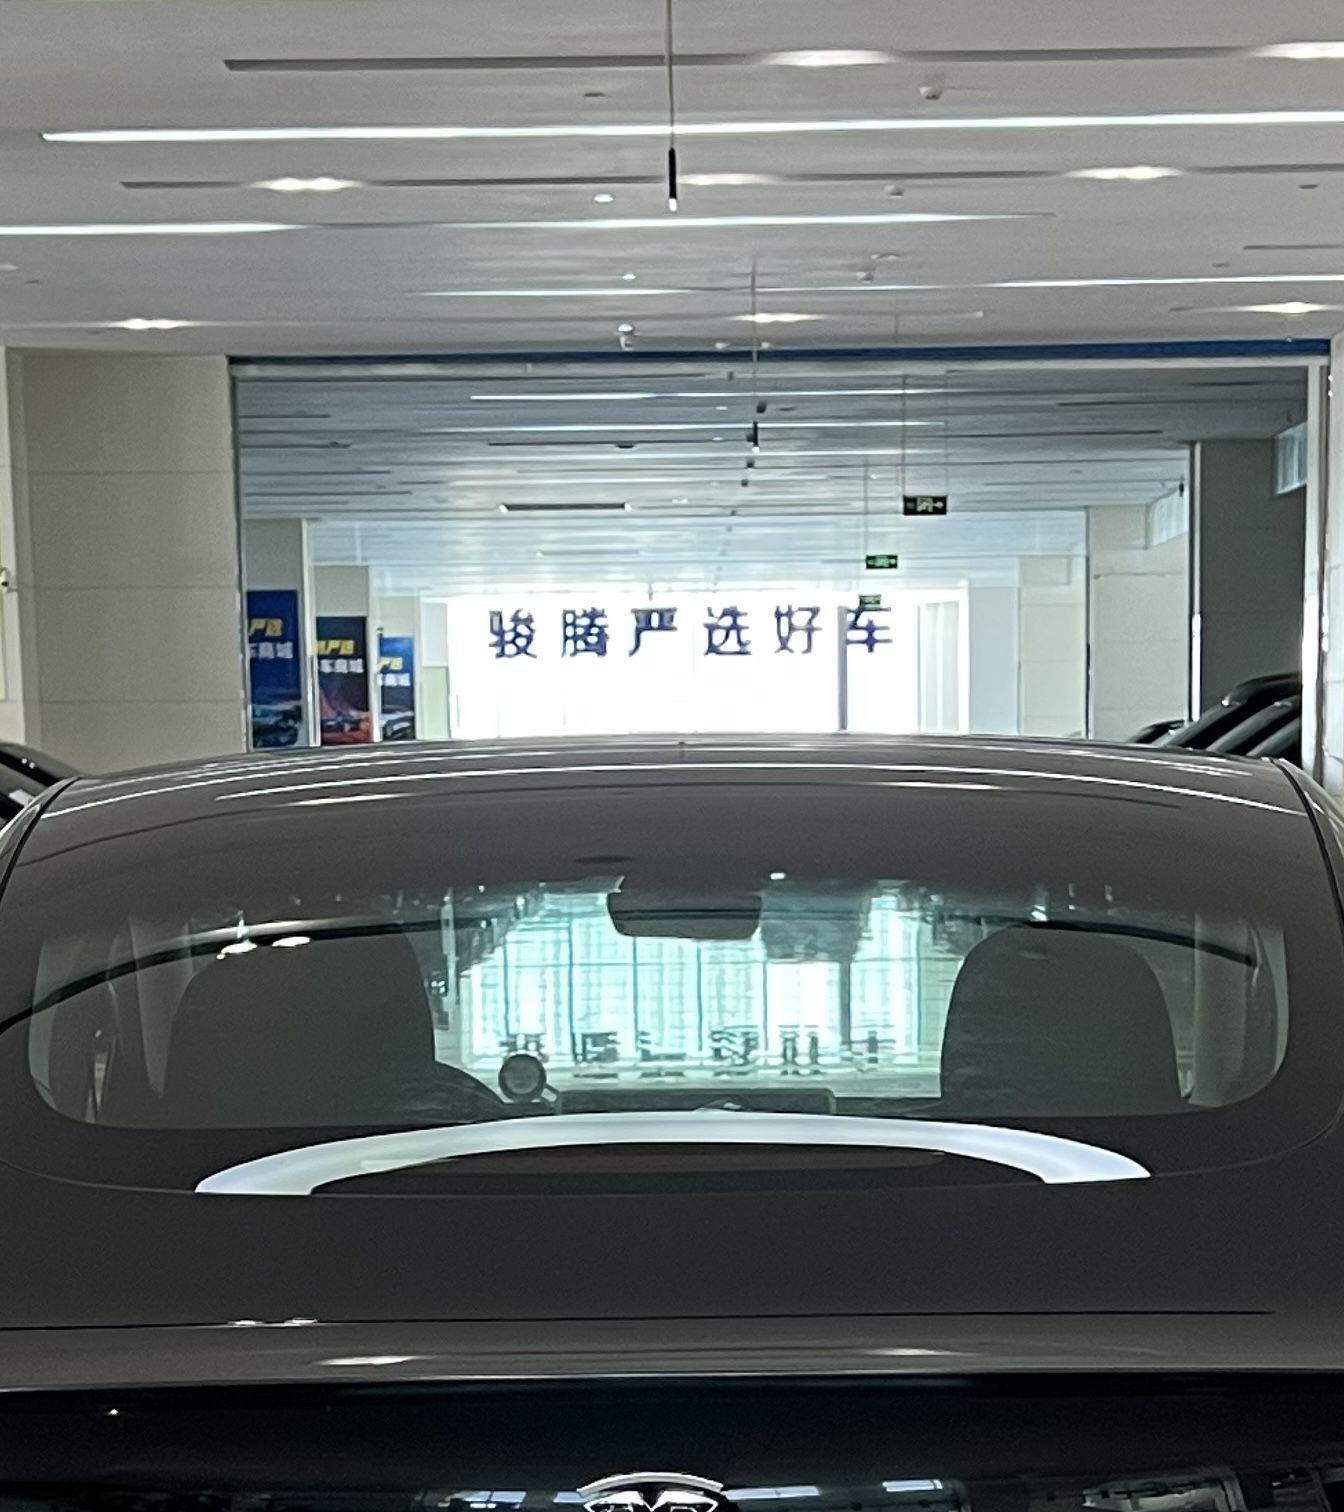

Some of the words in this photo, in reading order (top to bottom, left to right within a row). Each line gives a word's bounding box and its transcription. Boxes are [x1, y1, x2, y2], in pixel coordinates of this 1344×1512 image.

[488, 606, 894, 658] 骏腾严选好车
